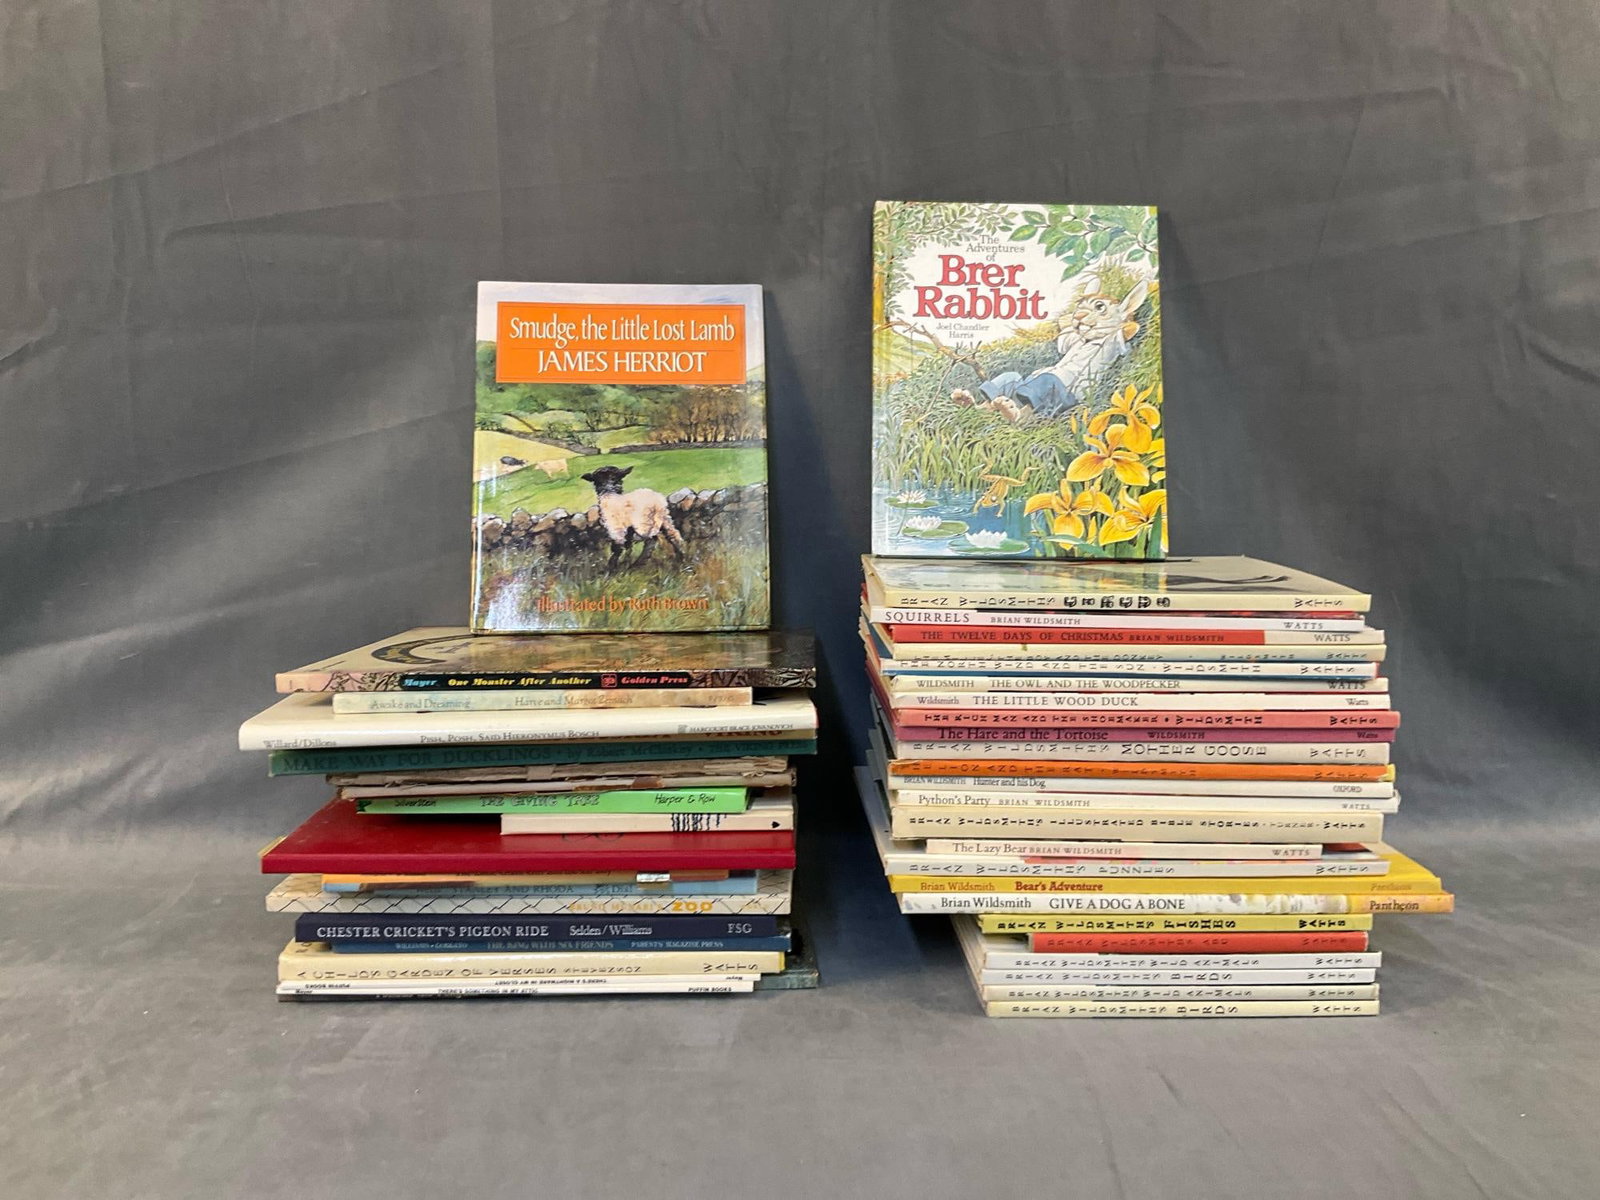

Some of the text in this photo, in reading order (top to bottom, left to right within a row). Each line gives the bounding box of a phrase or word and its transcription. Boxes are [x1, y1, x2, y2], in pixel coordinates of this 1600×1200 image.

[979, 234, 1000, 244] The
[966, 243, 1026, 254] Adventures
[986, 253, 997, 263] of
[936, 254, 1026, 288] Brer
[913, 285, 1049, 320] Rabbit
[509, 312, 736, 350] Smudge, the Little Lost Lamb
[936, 322, 990, 332] Joel Chandler
[949, 331, 974, 339] Harris
[537, 350, 708, 374] JAMES HERRIOT
[537, 596, 709, 615] Illustrated by Ruth Brown
[901, 596, 948, 606] BRIAN
[1294, 597, 1344, 608] WATTS
[885, 610, 1325, 630] SQUIRRELS BRIAN WILDSMITH WATTS
[920, 631, 1352, 643] THE TWELVE DAYS OF CHRISTMAS BRIAN WILDSMITH WATTS
[937, 661, 987, 669] NORTH
[994, 661, 1034, 670] WIND
[1042, 662, 1071, 670] AND
[1115, 662, 1145, 671] SUN
[1300, 664, 1355, 674] WATTS
[403, 676, 688, 688] Mayer One Monster After Another Golden Press
[916, 679, 1366, 690] WILDSMITH THE OWL AND THE WOODPECKER WATTS
[917, 695, 1370, 707] Wildsmith THE LITTLE WOOD DUCK Watts
[924, 713, 948, 722] THE
[955, 713, 988, 722] RICH
[993, 714, 1017, 723] MAN
[1022, 714, 1047, 723] AND
[1052, 714, 1077, 723] THE
[1175, 715, 1263, 725] WILDSMITH
[1329, 716, 1378, 726] WATTS
[478, 723, 794, 741] SAID HIERONYMUS BOSCH HARCOURT BRACE JOVANOVICH
[938, 728, 1378, 741] The Hare and the Tortoise WILDSMITH Watts
[913, 742, 1367, 758] BRIAN MOTHER GOOSE WATTS
[284, 747, 551, 771] MAKE WAY FOR DUCKLINGS
[1030, 779, 1363, 793] Dog OXFORD
[479, 793, 717, 807] THE GIVING TREE Harper Row
[918, 794, 963, 807] Python's
[964, 795, 991, 807] Party
[998, 798, 1029, 806] BRIAN
[1034, 799, 1090, 808] WILDSMITH
[909, 817, 952, 825] BRIAN
[1050, 818, 1144, 827] ILLUSTRATED
[1150, 819, 1194, 827] BIBLE
[1199, 820, 1259, 829] STORIES
[1323, 821, 1366, 830] WATTS
[952, 842, 1311, 857] The Lazy Bear BRIAN WILDSMITH WATTS
[909, 864, 1369, 875] BRIAN PUZZLES WATTS
[920, 881, 1104, 892] Brian Wildsmith Bear's Adventure
[671, 901, 713, 912] ZOO
[941, 896, 1420, 912] Brian Wildsmith GIVE A DOG A BONE Pantheon
[316, 923, 752, 938] CHESTER CRICKET'S PIGEON RIDE FSG
[997, 918, 1347, 930] BRIAN FISHES WATTS
[1015, 957, 1363, 967] BRIAN WILD ANIMALS WATTS
[387, 963, 759, 979] GARDEN OF VERSES STEVENSON WATTS
[1005, 971, 1357, 981] BRIAN BIRDS WATTS
[1009, 989, 1356, 998] BRIAN WILD ANIMALS WATTS
[1012, 1004, 1361, 1015] BRIAN BIRDS WATTS
